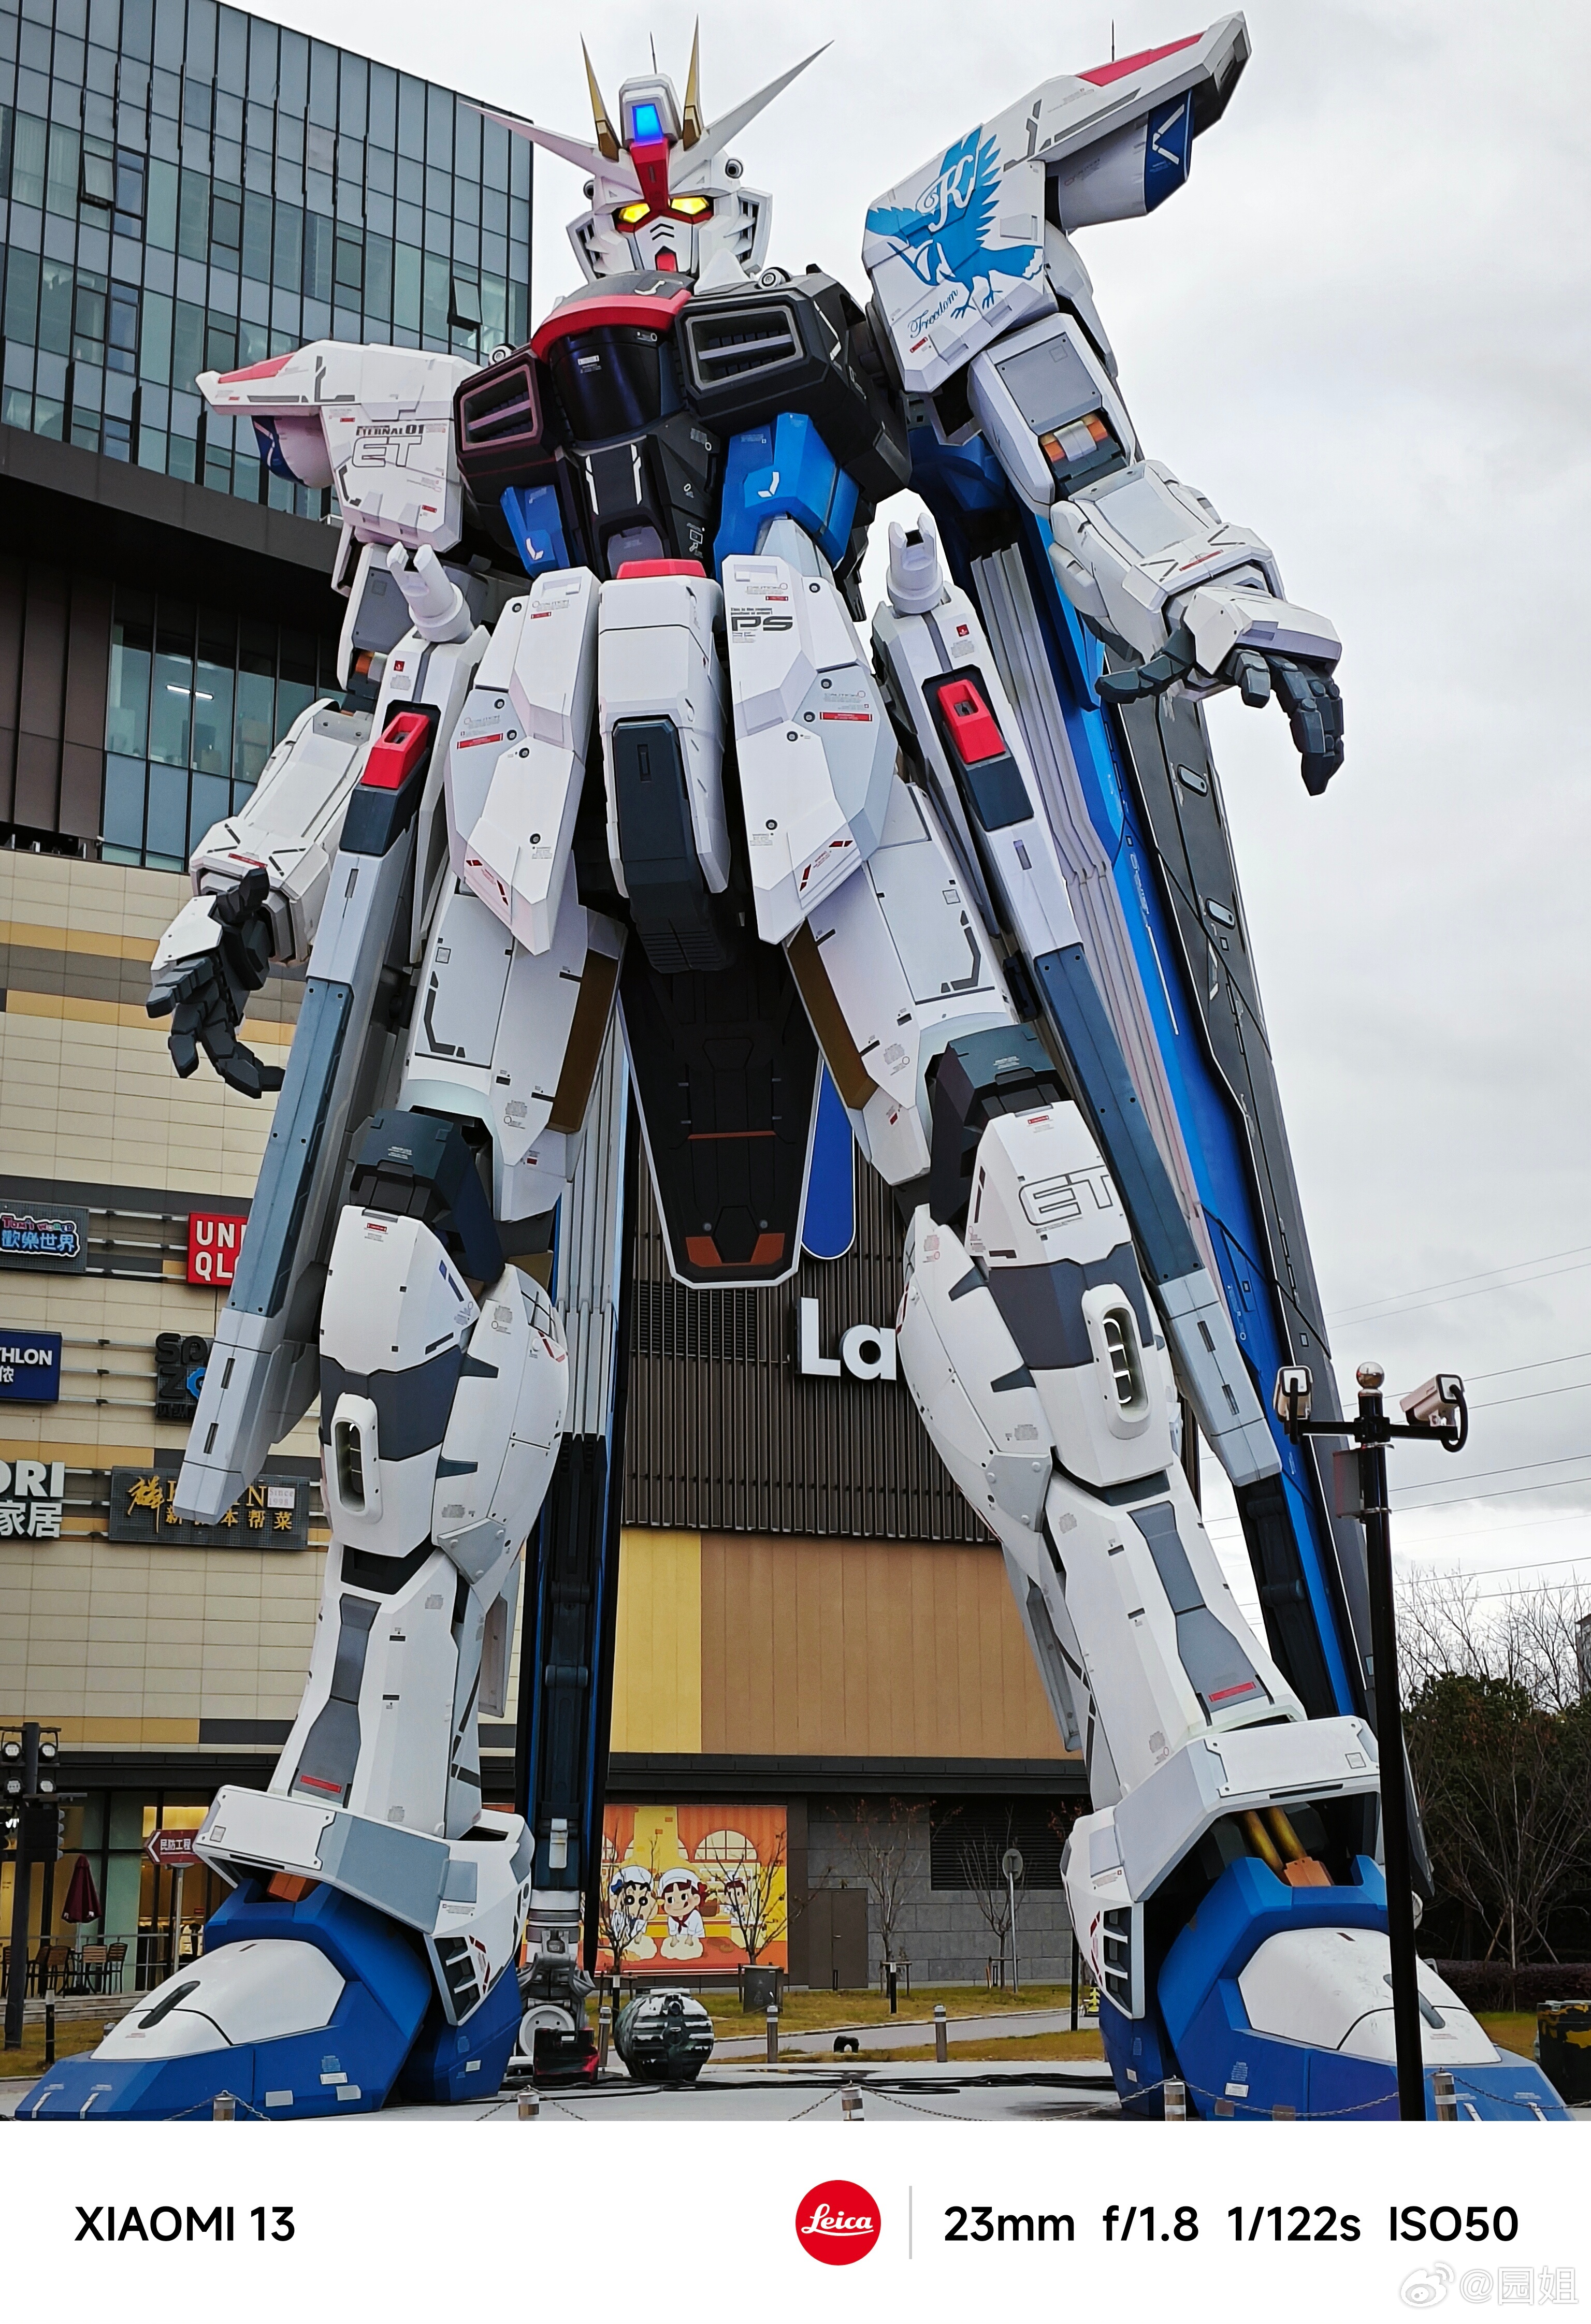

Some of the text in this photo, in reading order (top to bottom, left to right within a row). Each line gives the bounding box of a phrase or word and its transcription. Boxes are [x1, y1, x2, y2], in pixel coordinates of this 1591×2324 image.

[907, 289, 958, 339] Freedom
[352, 435, 423, 468] ET
[731, 616, 793, 631] PS
[1018, 1165, 1114, 1226] ET
[2, 1229, 75, 1252] 歡樂世界
[195, 1251, 240, 1282] QL
[0, 1347, 53, 1366] HLON
[0, 1500, 63, 1538] 家居
[165, 1504, 293, 1531] 新本帮菜
